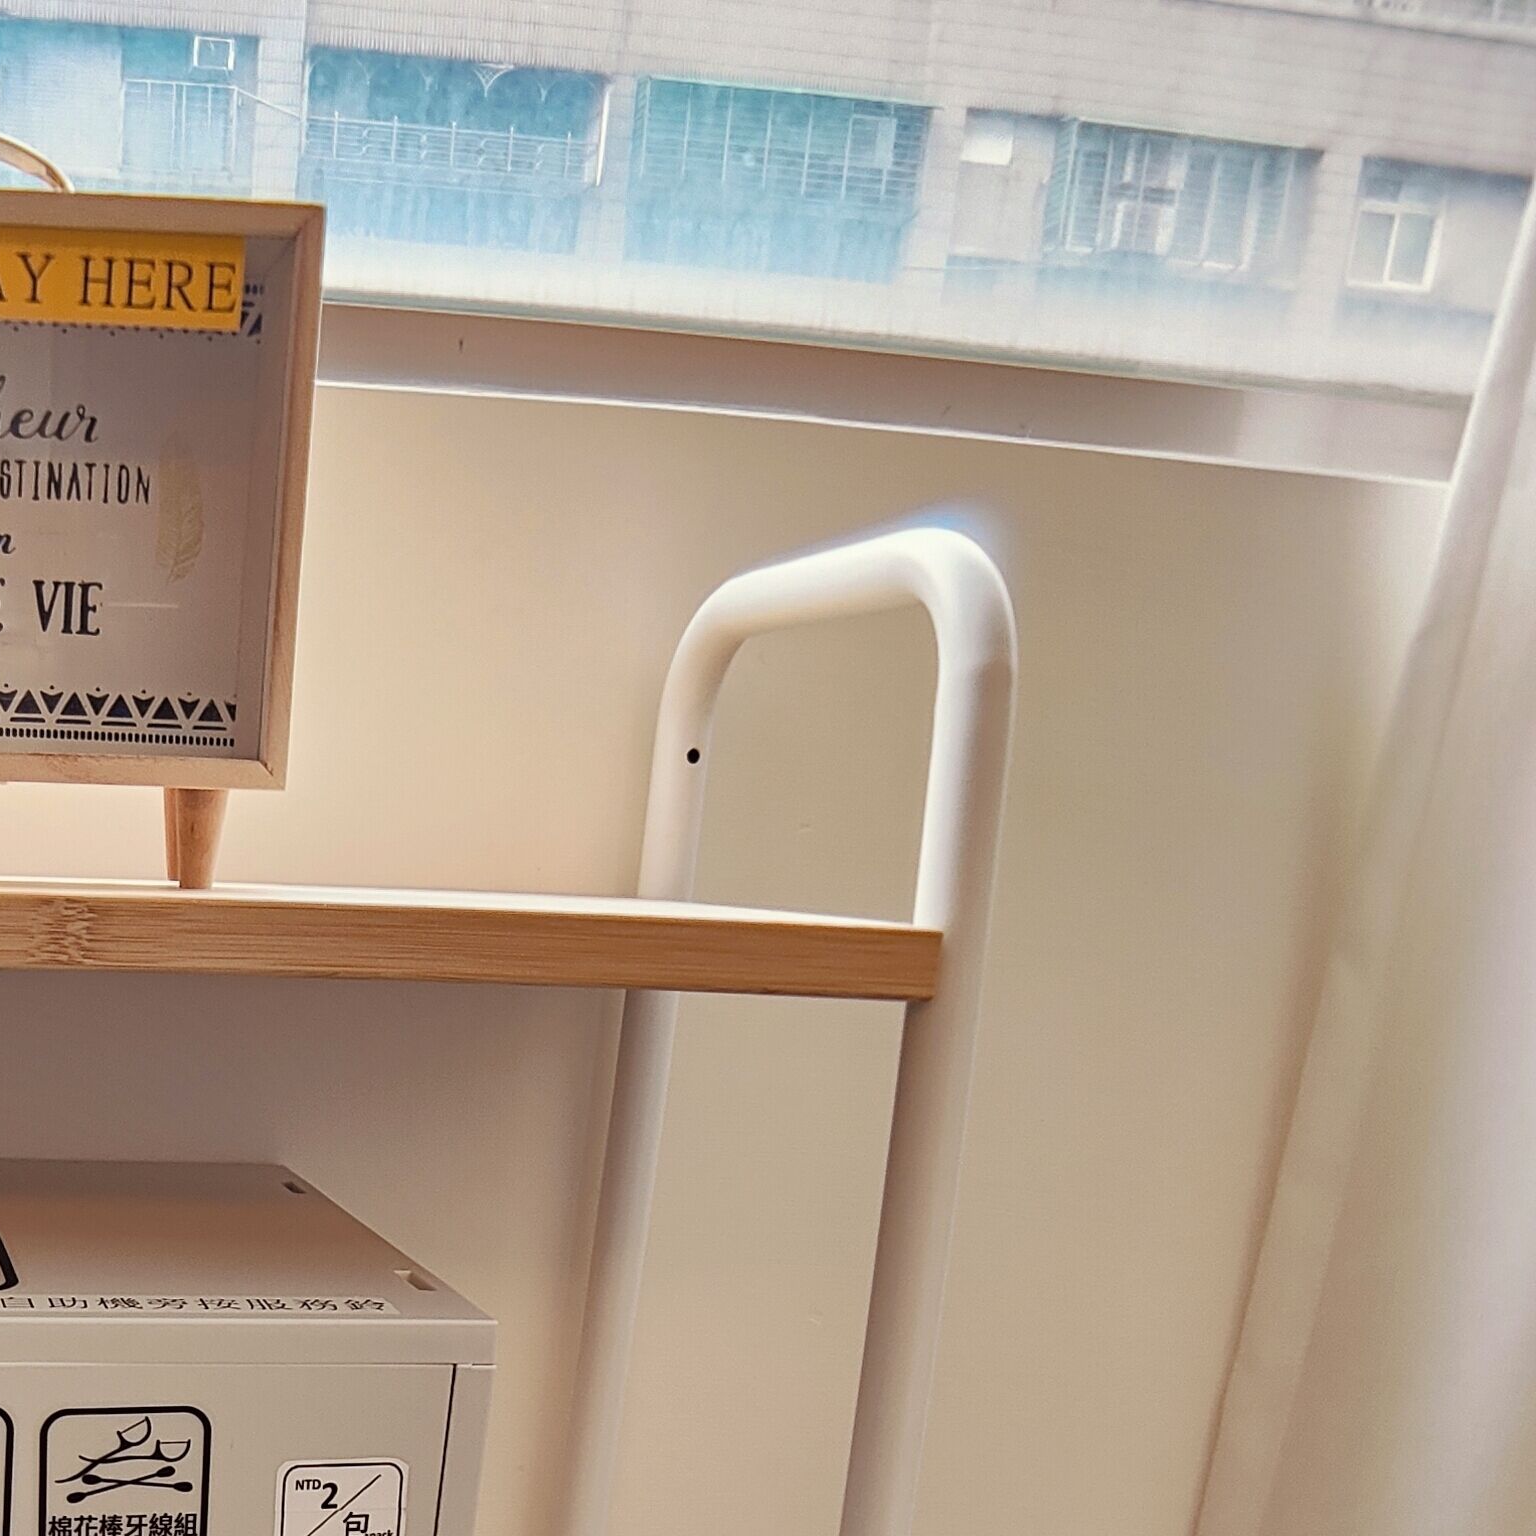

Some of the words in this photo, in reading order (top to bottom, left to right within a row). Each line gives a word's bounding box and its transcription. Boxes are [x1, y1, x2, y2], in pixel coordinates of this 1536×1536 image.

[79, 256, 239, 316] HERE
[33, 579, 105, 637] VIE
[295, 1479, 321, 1491] NTD
[321, 1482, 339, 1510] 2
